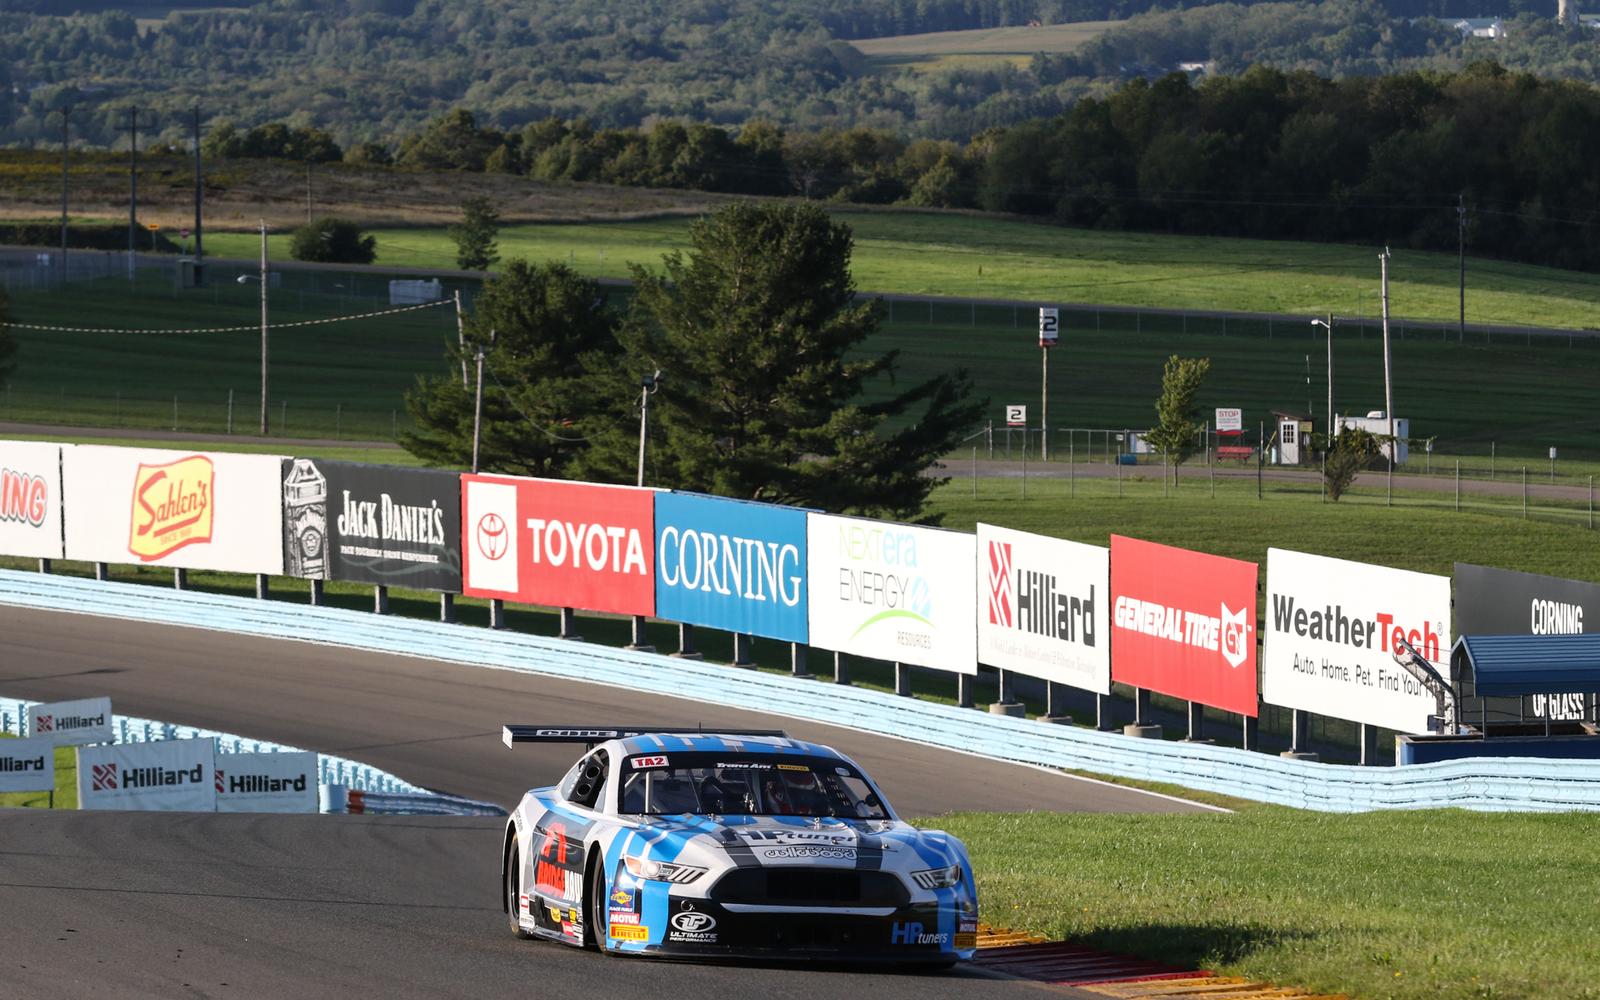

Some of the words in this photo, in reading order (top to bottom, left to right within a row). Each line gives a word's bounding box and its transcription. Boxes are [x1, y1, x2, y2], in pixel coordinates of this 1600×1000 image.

[1043, 316, 1057, 331] 2
[1011, 409, 1021, 420] 2
[1218, 410, 1239, 418] STOP
[137, 470, 207, 536] Sahlen's
[337, 489, 379, 539] JACK
[527, 518, 647, 576] TOYOTA
[839, 524, 918, 568] NEXTera
[659, 526, 802, 607] CORNING
[840, 567, 909, 608] ENERGY
[1017, 568, 1096, 647] Hilliard
[1114, 595, 1184, 643] GENERAL
[1184, 611, 1221, 651] TIRE
[1531, 598, 1583, 635] CORNING
[897, 630, 931, 649] RESOURCES
[1293, 652, 1317, 675] Auto.
[1322, 658, 1351, 682] Home.
[1356, 664, 1374, 687] Pet.
[1379, 669, 1399, 692] Find
[56, 714, 104, 731] Hilliard
[122, 763, 203, 789] Hilliard
[635, 757, 665, 767] TA2
[230, 774, 306, 793] Hilliard
[610, 913, 639, 925] MOTUL
[670, 931, 718, 939] ULTIMATE
